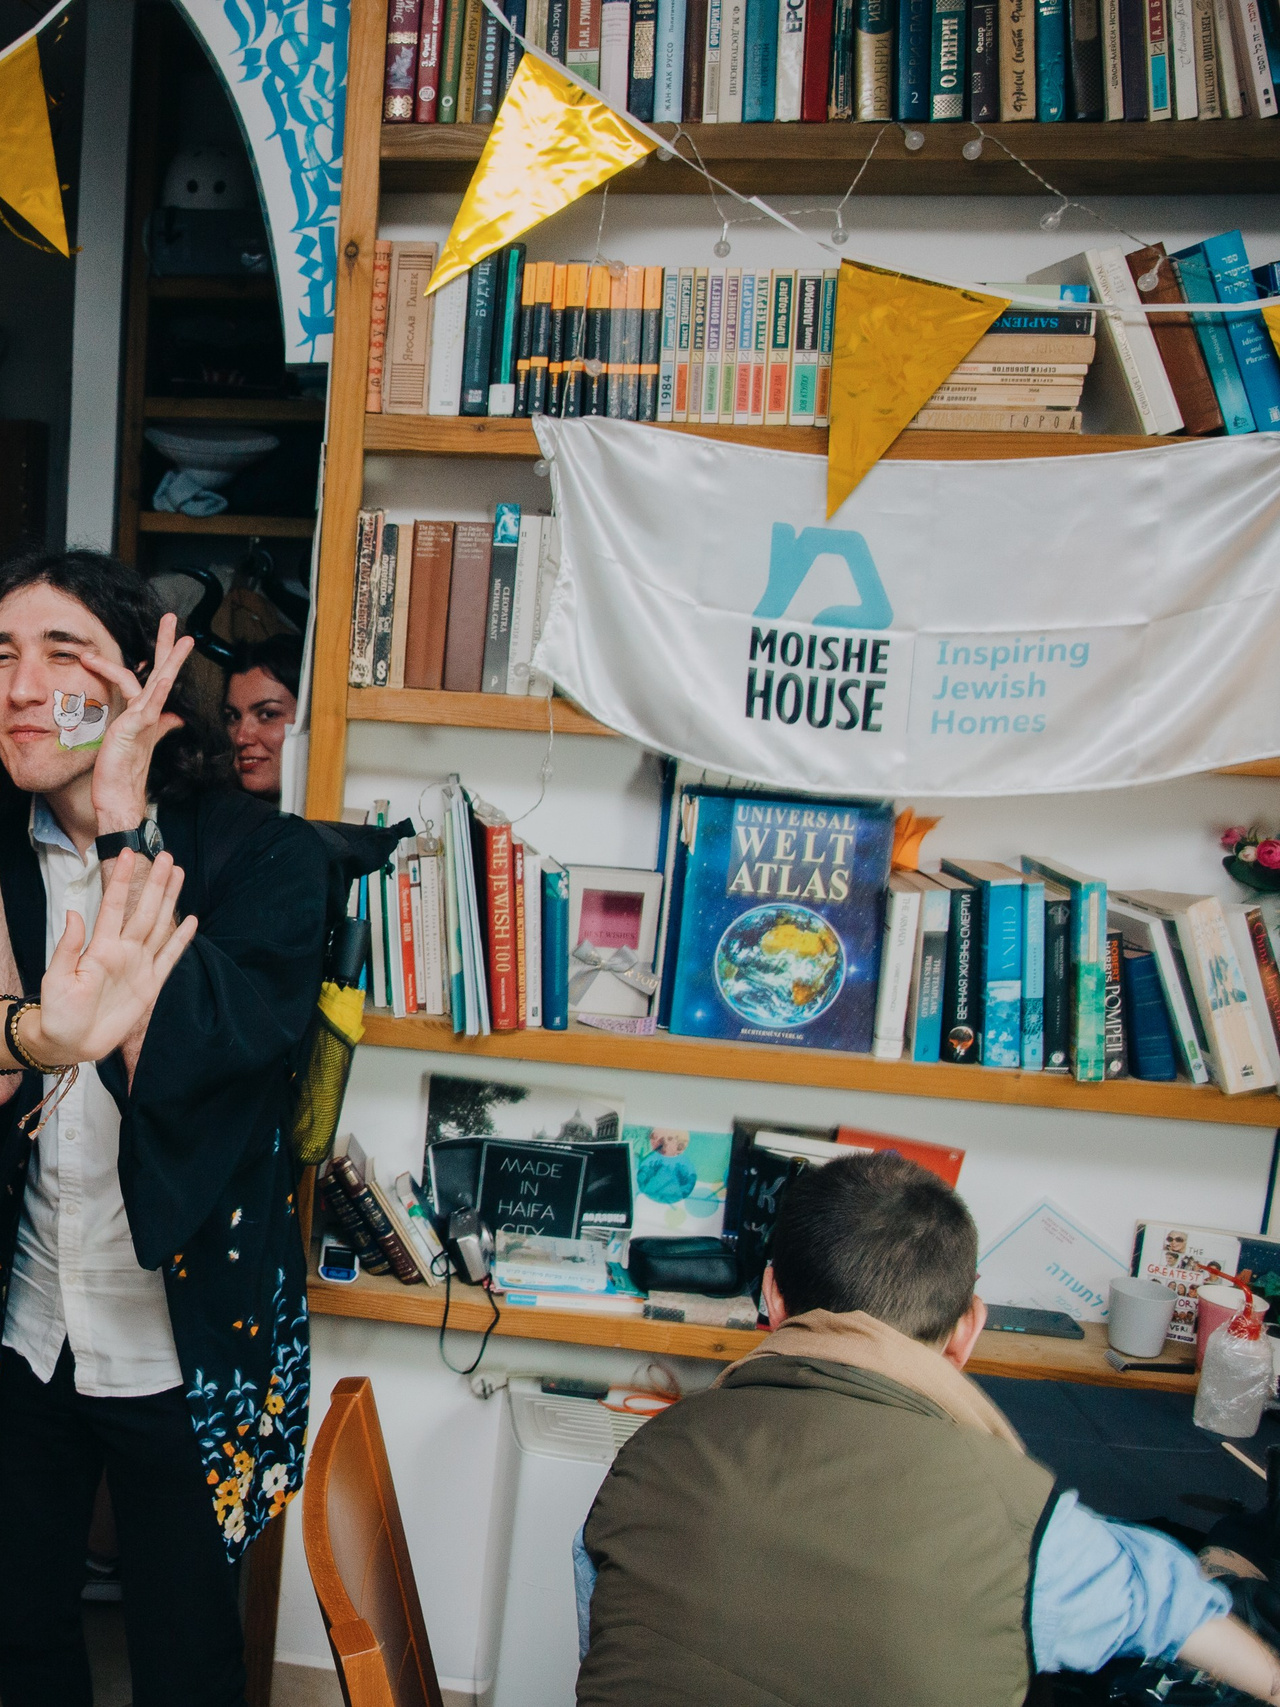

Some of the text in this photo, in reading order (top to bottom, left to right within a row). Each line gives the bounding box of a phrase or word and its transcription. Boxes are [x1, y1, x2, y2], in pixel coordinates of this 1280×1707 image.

[469, 17, 477, 42] КОМУ
[551, 3, 562, 56] Мост через
[579, 0, 591, 26] ГУМИ
[709, 9, 720, 45] ФРИДРИХ
[909, 0, 923, 32] ПАСТ
[940, 17, 958, 88] О.ГЕНРИ
[975, 27, 985, 53] Федор
[1201, 15, 1216, 104] ЕВГЕНИЙ ОНЕГИН
[466, 54, 475, 82] ЗАЧЕМ
[664, 42, 674, 111] ЖАН-ЖАК РУССО
[729, 29, 740, 96] ДОСТОЕВСКИЙ
[874, 39, 889, 111] БРЭДБЕРИ
[911, 92, 919, 104] 2
[1221, 253, 1239, 264] ספר
[407, 273, 419, 307] ГАШЕК
[475, 260, 491, 317] БУДУЩ
[665, 280, 677, 317] ОРУЭЛЛ
[680, 278, 691, 324] ХЕМИНГУЭЙ
[695, 280, 706, 323] ФРОММ
[743, 278, 753, 308] САРТР
[756, 282, 768, 322] КЕРУАК
[710, 279, 722, 349] КУРТ ВОННЕГУТ
[726, 279, 738, 349] КУРТ ВОННЕГУТ
[776, 281, 788, 344] ШАРЛЬ БОДЛЕР
[803, 280, 815, 350] ГОВАРД ЛАВКРАФТ
[991, 317, 1059, 329] SAPIENS
[1241, 335, 1265, 346] Idioms
[1245, 353, 1271, 365] Phrases
[661, 375, 673, 407] 1984
[490, 578, 501, 641] MICHAEL GRANT
[500, 586, 511, 633] CLEOPATRA
[749, 626, 891, 675] MOISHE
[936, 637, 1091, 671] Inspiring
[745, 666, 887, 733] HOUSE
[932, 671, 1047, 701] Jewish
[930, 709, 1047, 736] Homes
[737, 805, 856, 832] UNIVERSAL
[735, 825, 854, 866] WELT
[516, 884, 524, 906] АТЛАС
[728, 861, 851, 902] ATLAS
[489, 831, 511, 973] THE JEWISH 100
[403, 922, 412, 942] BERLIN
[1001, 906, 1017, 970] CHINA
[1253, 922, 1270, 973] China's
[956, 894, 971, 1020] ВЕЧНАЯ ЖИЗНЬ СМЕРТИ
[1110, 940, 1120, 982] ROBERT
[635, 972, 659, 989] YOU
[921, 955, 933, 1018] PIERS PAUL READ
[930, 959, 941, 1014] THE TEMPLARS
[1104, 985, 1122, 1052] POMPEII
[500, 1157, 563, 1179] MADE
[520, 1180, 539, 1197] IN
[498, 1200, 556, 1221] HAIFA
[1188, 1247, 1204, 1256] THE
[1045, 1262, 1104, 1308] לתעודה
[1147, 1263, 1201, 1281] GREATEST
[1178, 1299, 1200, 1310] ORY
